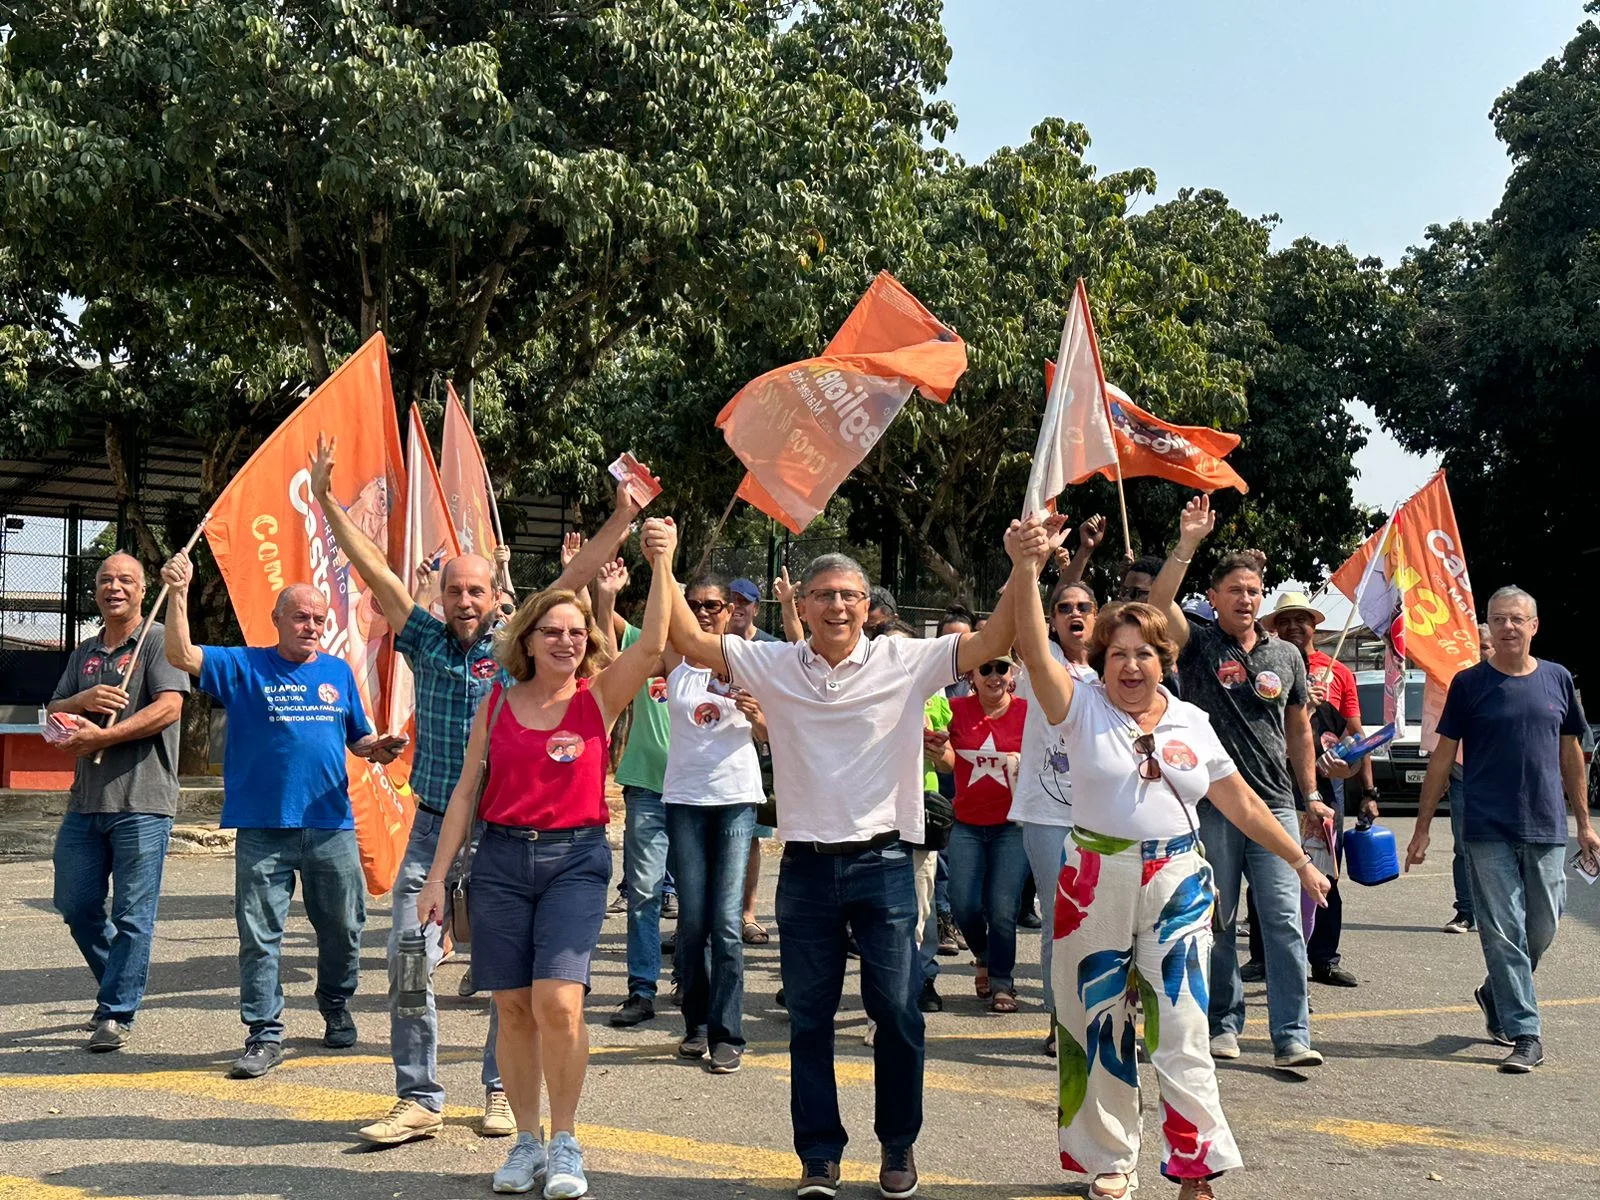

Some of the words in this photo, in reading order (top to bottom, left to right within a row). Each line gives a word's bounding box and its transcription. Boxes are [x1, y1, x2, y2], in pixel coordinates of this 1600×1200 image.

[264, 685, 277, 694] EU
[278, 684, 308, 693] APOIO
[975, 756, 999, 768] PT
